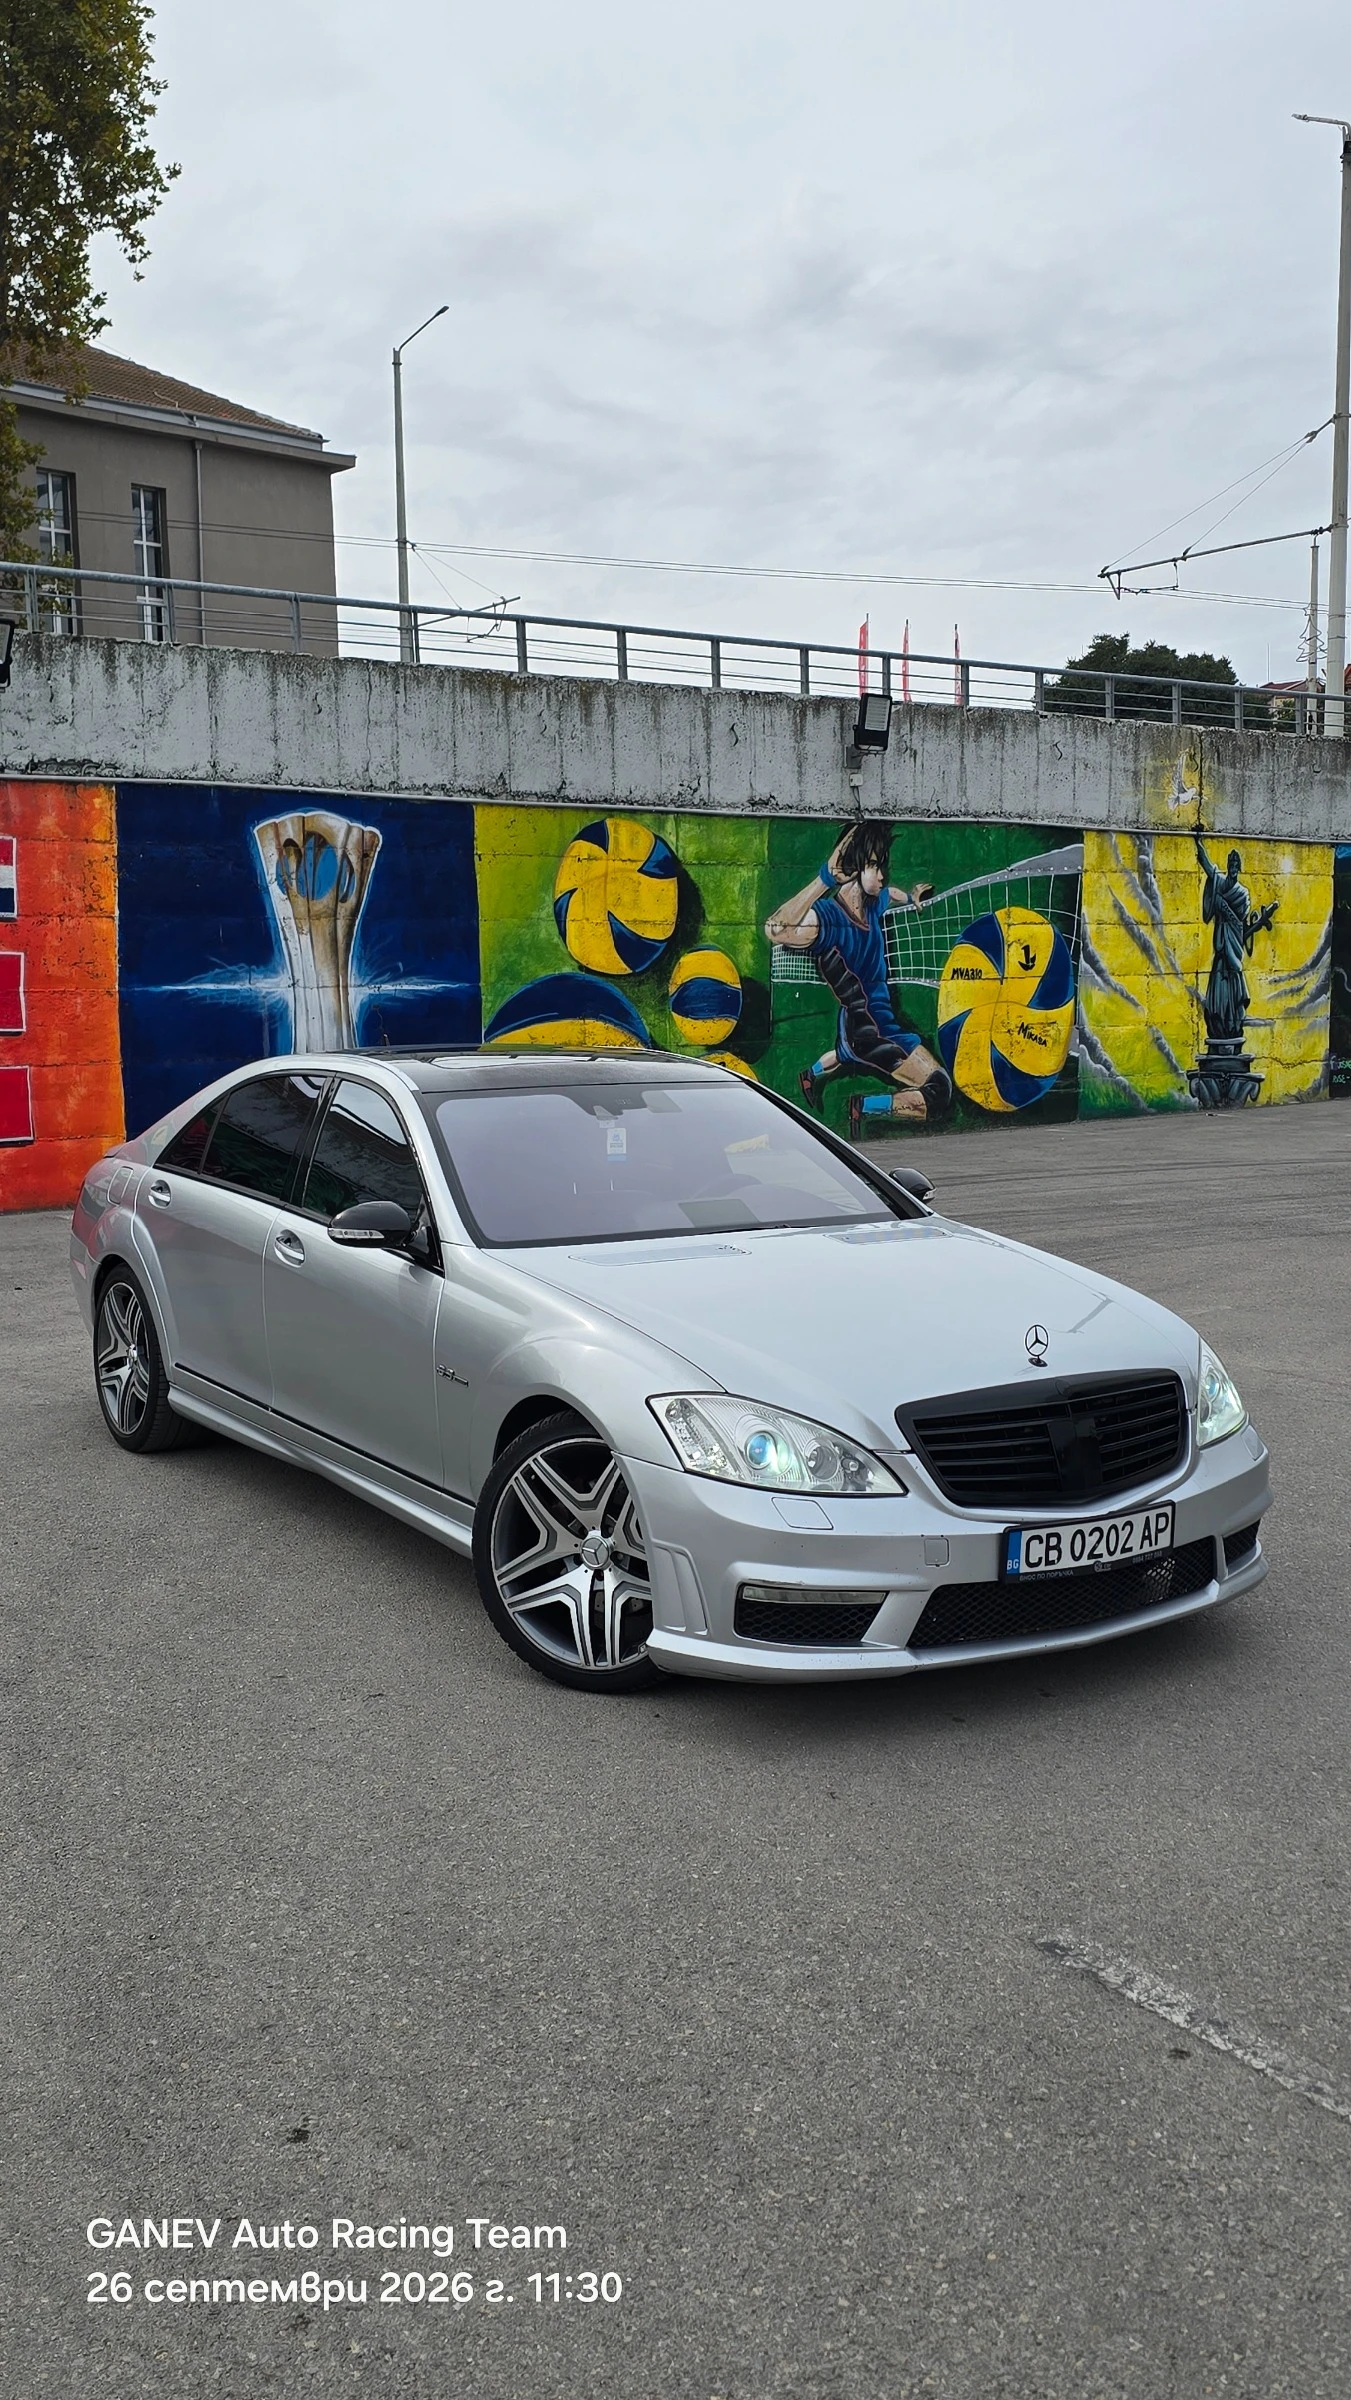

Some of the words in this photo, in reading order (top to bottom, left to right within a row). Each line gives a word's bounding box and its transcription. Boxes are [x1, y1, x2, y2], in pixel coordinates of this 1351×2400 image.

[1024, 1532, 1063, 1568] CB
[1070, 1520, 1134, 1562] 0202
[1139, 1512, 1170, 1550] AP
[1006, 1558, 1020, 1571] BG
